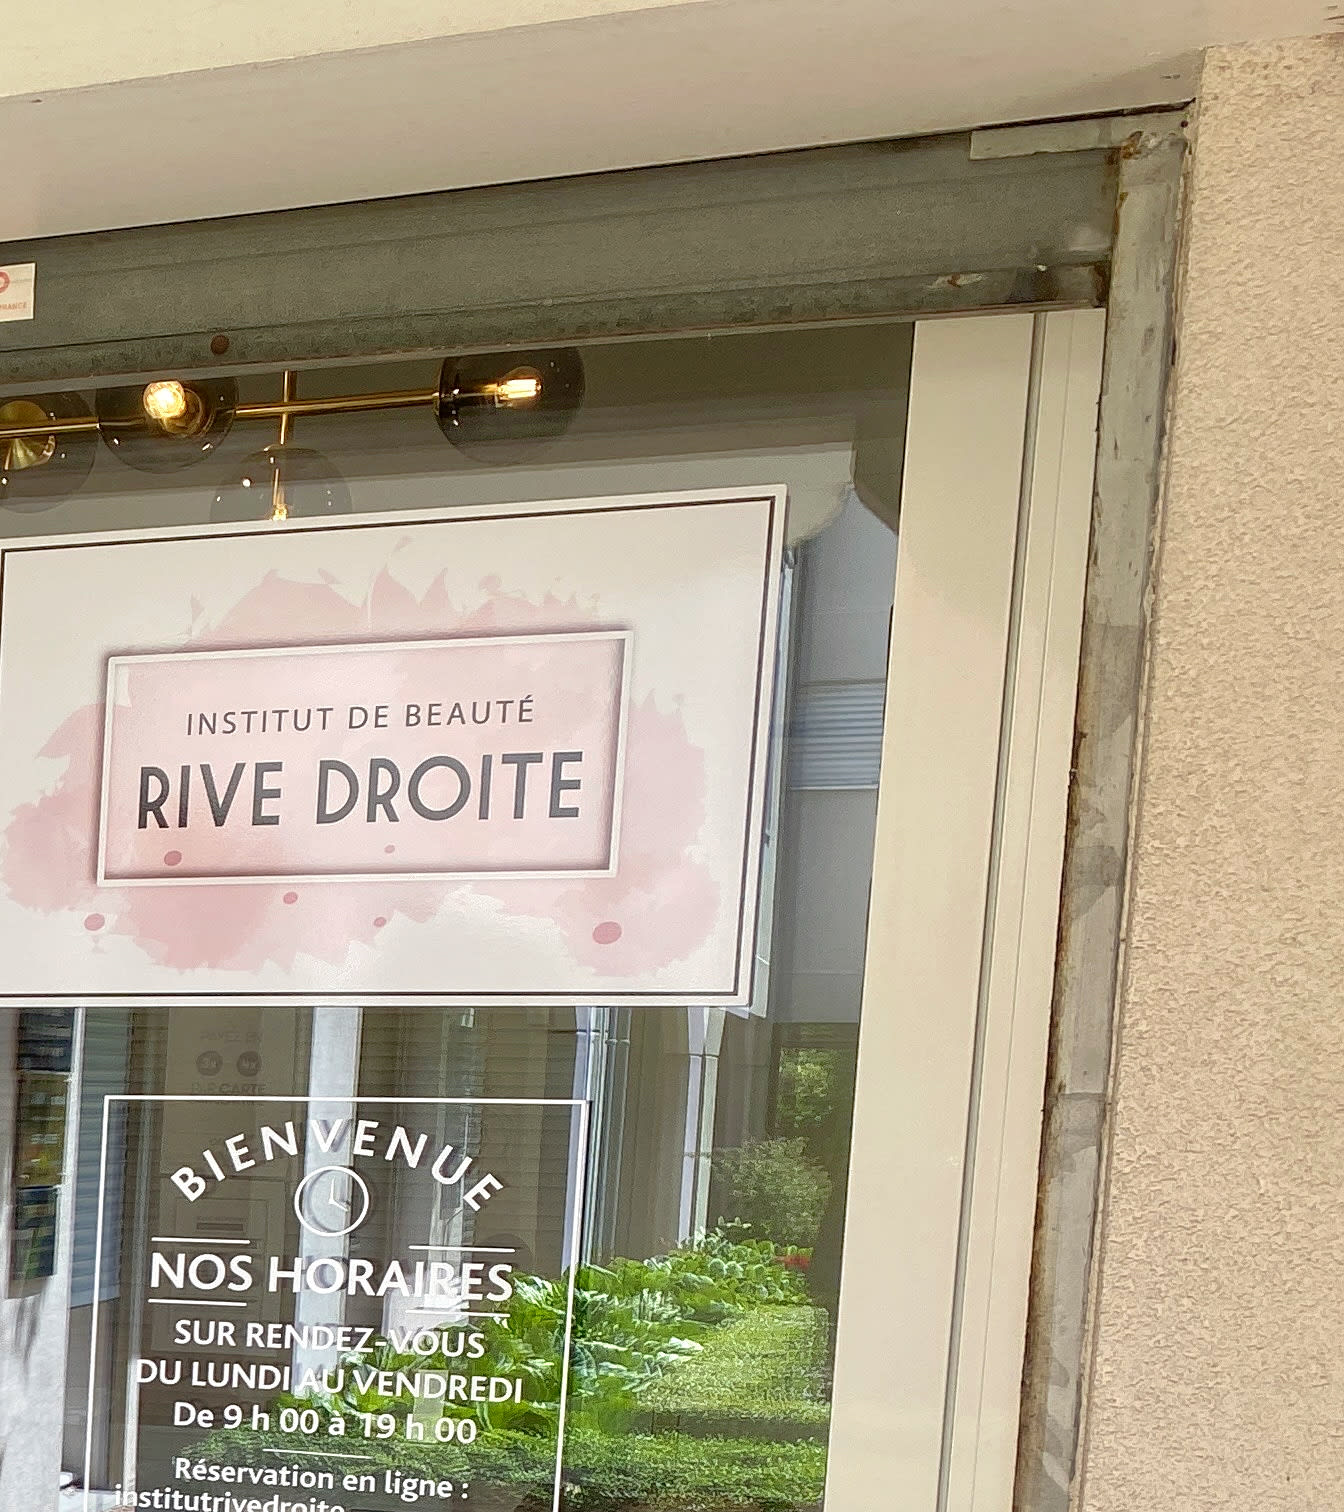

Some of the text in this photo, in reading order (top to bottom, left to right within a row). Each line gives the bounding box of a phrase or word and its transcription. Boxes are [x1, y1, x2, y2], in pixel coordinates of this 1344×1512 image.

[187, 695, 535, 735] INSTITUT DE BEAUTÉ
[138, 751, 583, 829] RIVE DROITE
[170, 1118, 504, 1214] BIENVENUE
[149, 1251, 513, 1303] NOS HORAIRES
[174, 1319, 486, 1359] SUR RENDEZ-VOUS
[136, 1359, 523, 1404] DU LUNDI AU VENDREDI
[173, 1403, 477, 1445] De 9 h 00 à 19 h 00
[174, 1456, 469, 1503] Réservation en ligne :
